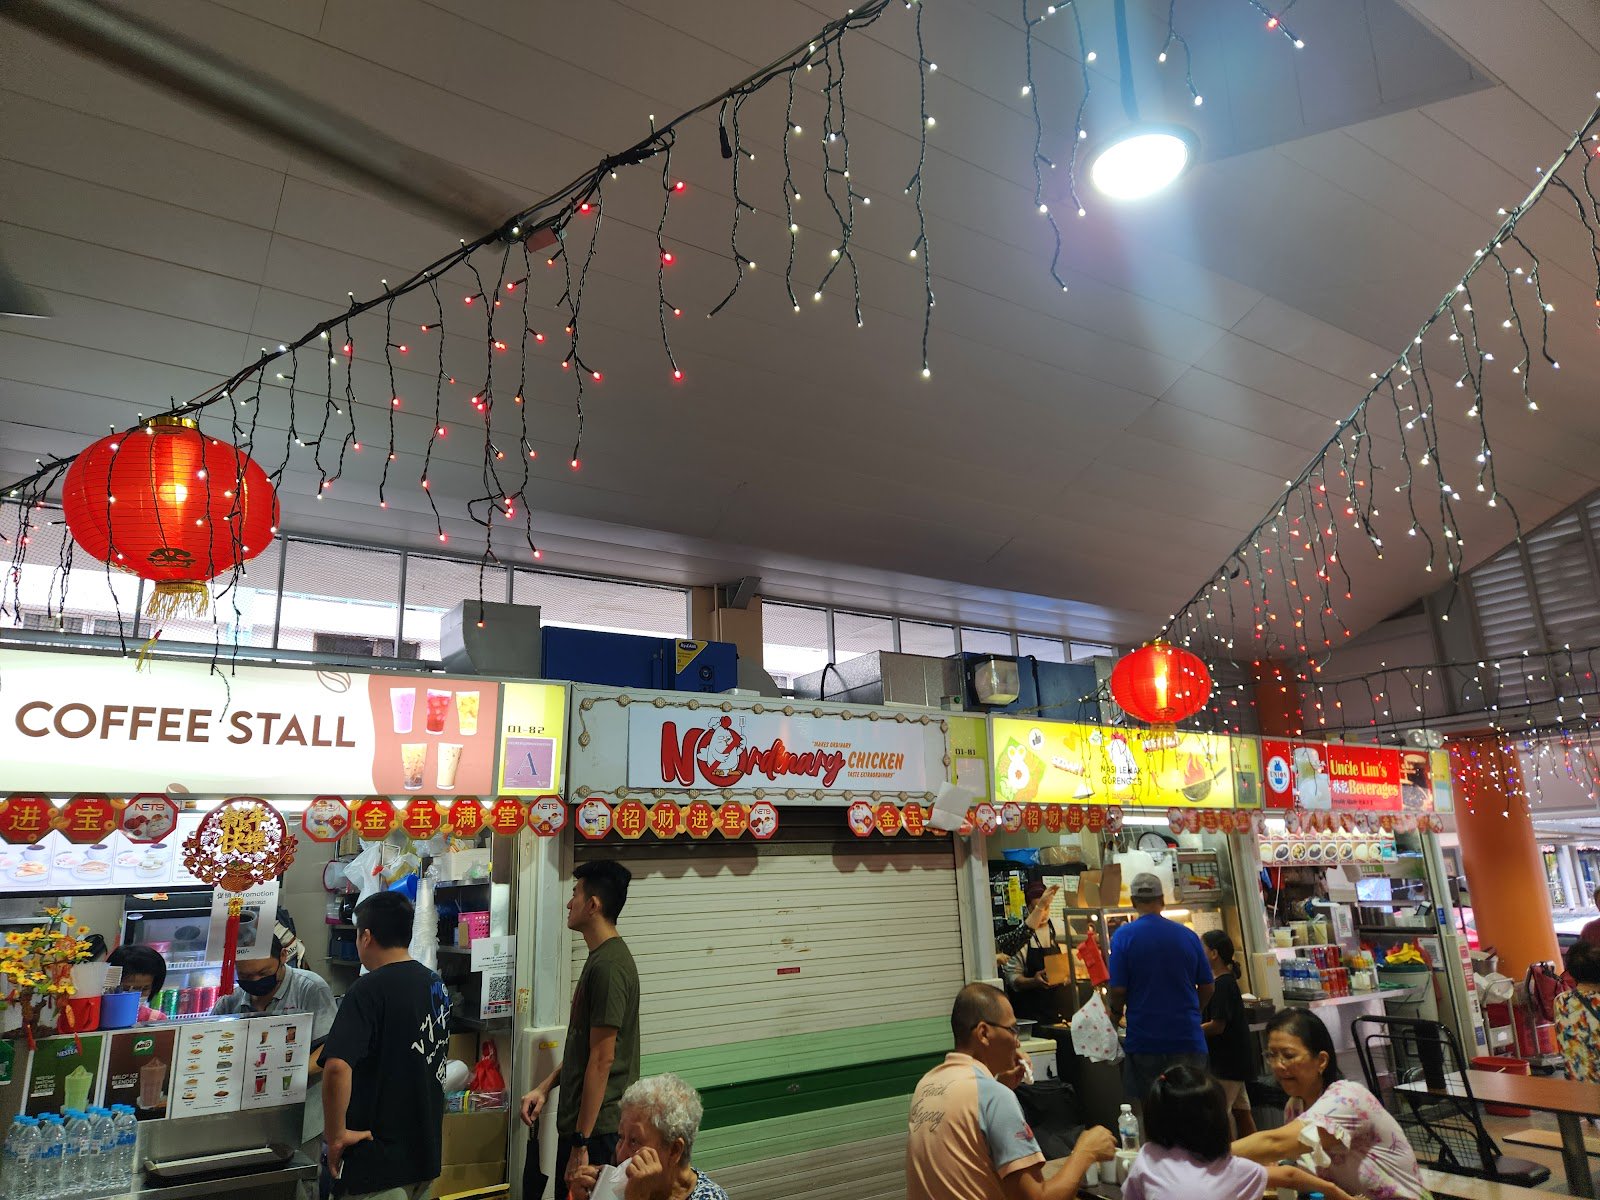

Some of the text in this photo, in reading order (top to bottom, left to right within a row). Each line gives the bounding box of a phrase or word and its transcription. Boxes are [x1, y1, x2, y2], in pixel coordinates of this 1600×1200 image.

[15, 700, 356, 748] COFFEE STALL
[848, 751, 904, 770] CHICKEN
[1101, 765, 1117, 774] NASI
[1330, 759, 1388, 778] Uncle Lim's
[1349, 781, 1399, 799] Beverages
[135, 803, 165, 811] NETS
[238, 890, 274, 899] Promotion
